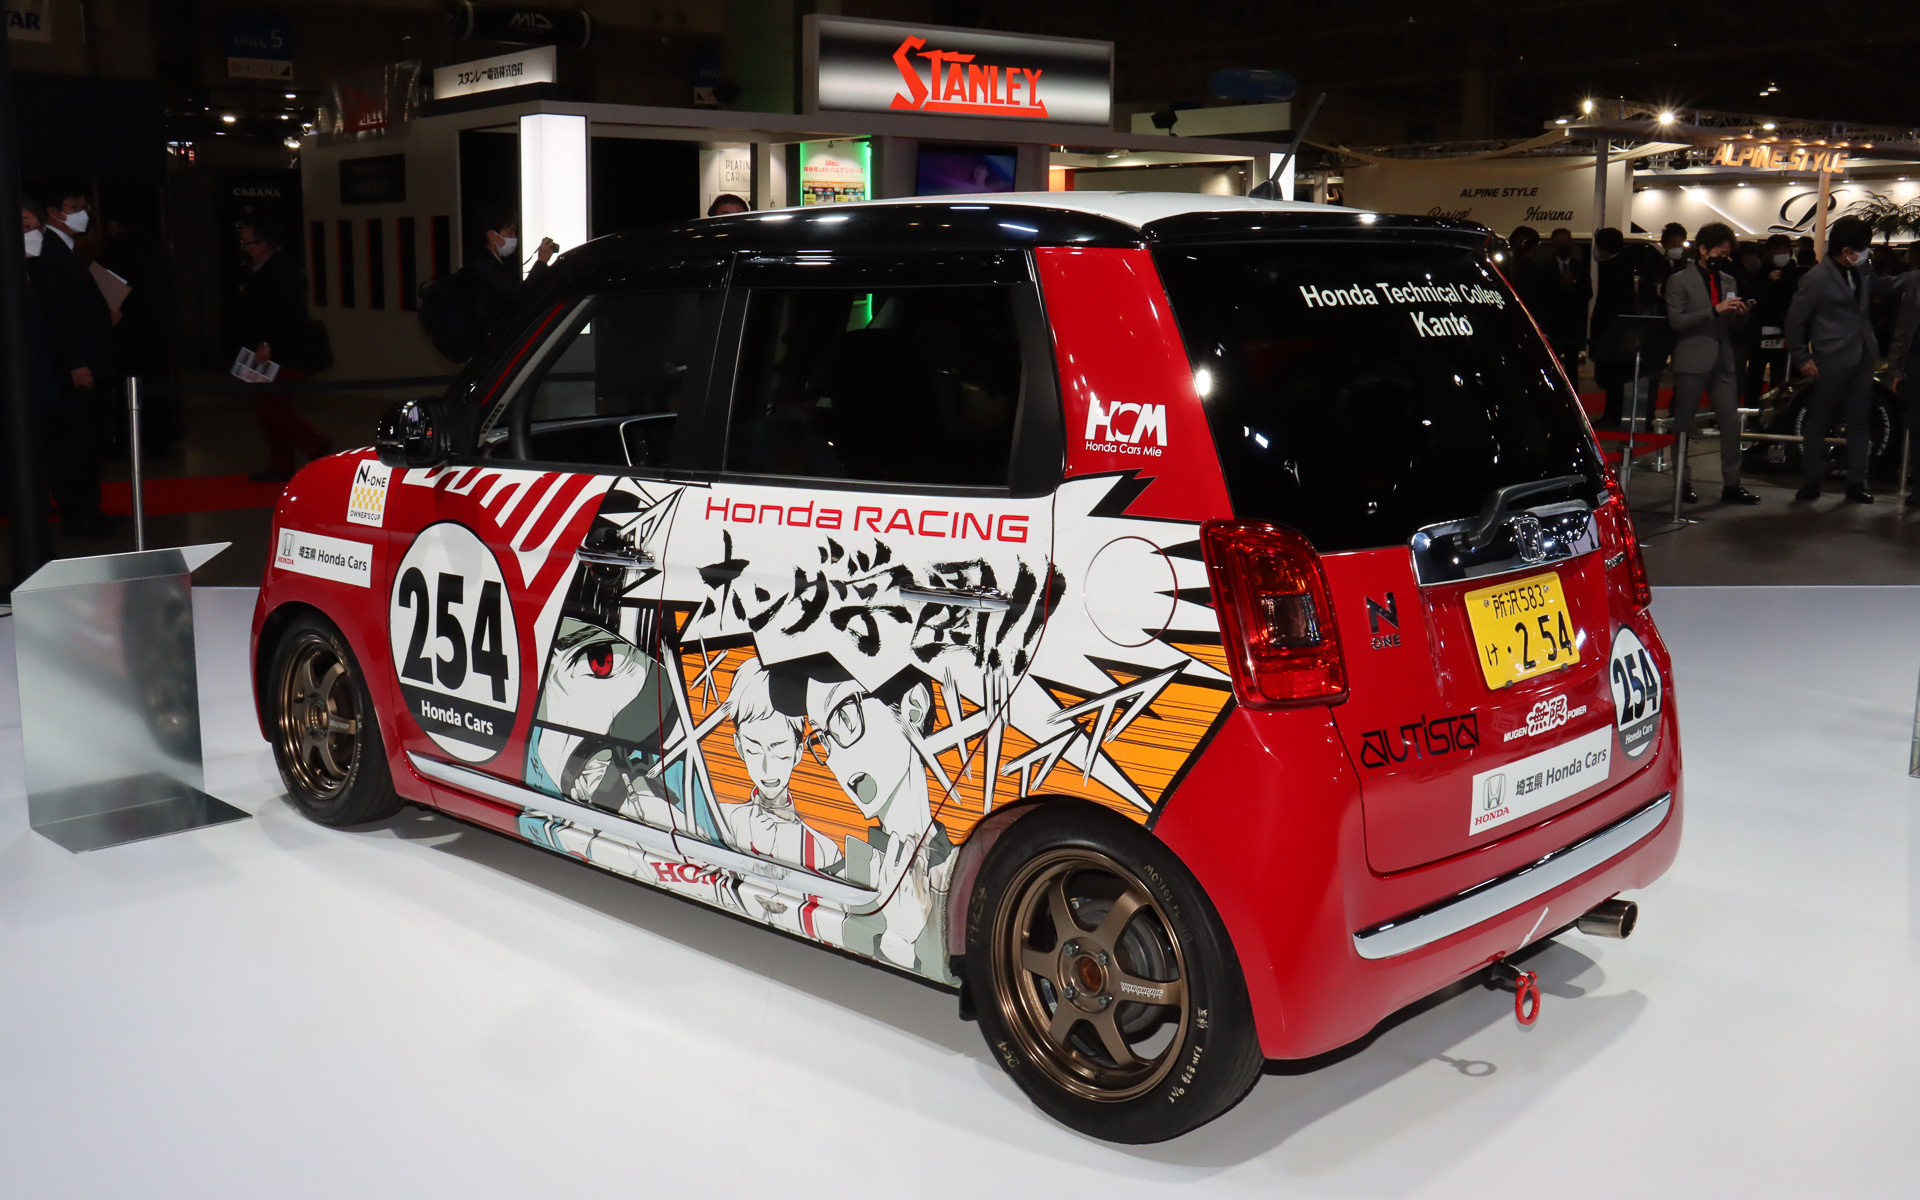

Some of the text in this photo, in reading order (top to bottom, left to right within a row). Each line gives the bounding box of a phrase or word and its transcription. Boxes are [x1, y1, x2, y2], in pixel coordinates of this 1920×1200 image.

[5, 10, 41, 30] AR
[234, 29, 284, 48] HALL 5
[889, 35, 1049, 117] STANLEY
[1711, 142, 1849, 173] ALPINE STYLE
[231, 186, 281, 198] CABANA
[1460, 187, 1539, 198] ALPINE STYLE
[1523, 205, 1574, 221] Havana
[1299, 281, 1506, 310] Honda Technical College
[1410, 311, 1474, 338] Kanto
[1085, 399, 1168, 447] HCM
[1085, 441, 1163, 457] Honda Cars Mie
[356, 464, 387, 488] N-ONE
[705, 496, 1030, 544] Honda RACING
[277, 556, 294, 566] HONDA
[298, 545, 367, 572] 埼玉県 Honda Cars
[398, 566, 509, 704] 254
[1370, 633, 1402, 650] ONE
[1612, 648, 1658, 726] 254
[421, 699, 494, 736] Honda Cars
[1526, 694, 1568, 737] 無限
[1567, 704, 1587, 720] POWER
[1503, 726, 1528, 743] MUGEN
[1625, 723, 1653, 745] Honda Cars
[1515, 748, 1607, 796] 埼玉県 Honda Cars
[1474, 806, 1510, 826] HONDA
[1143, 864, 1174, 903] MOTEGI
